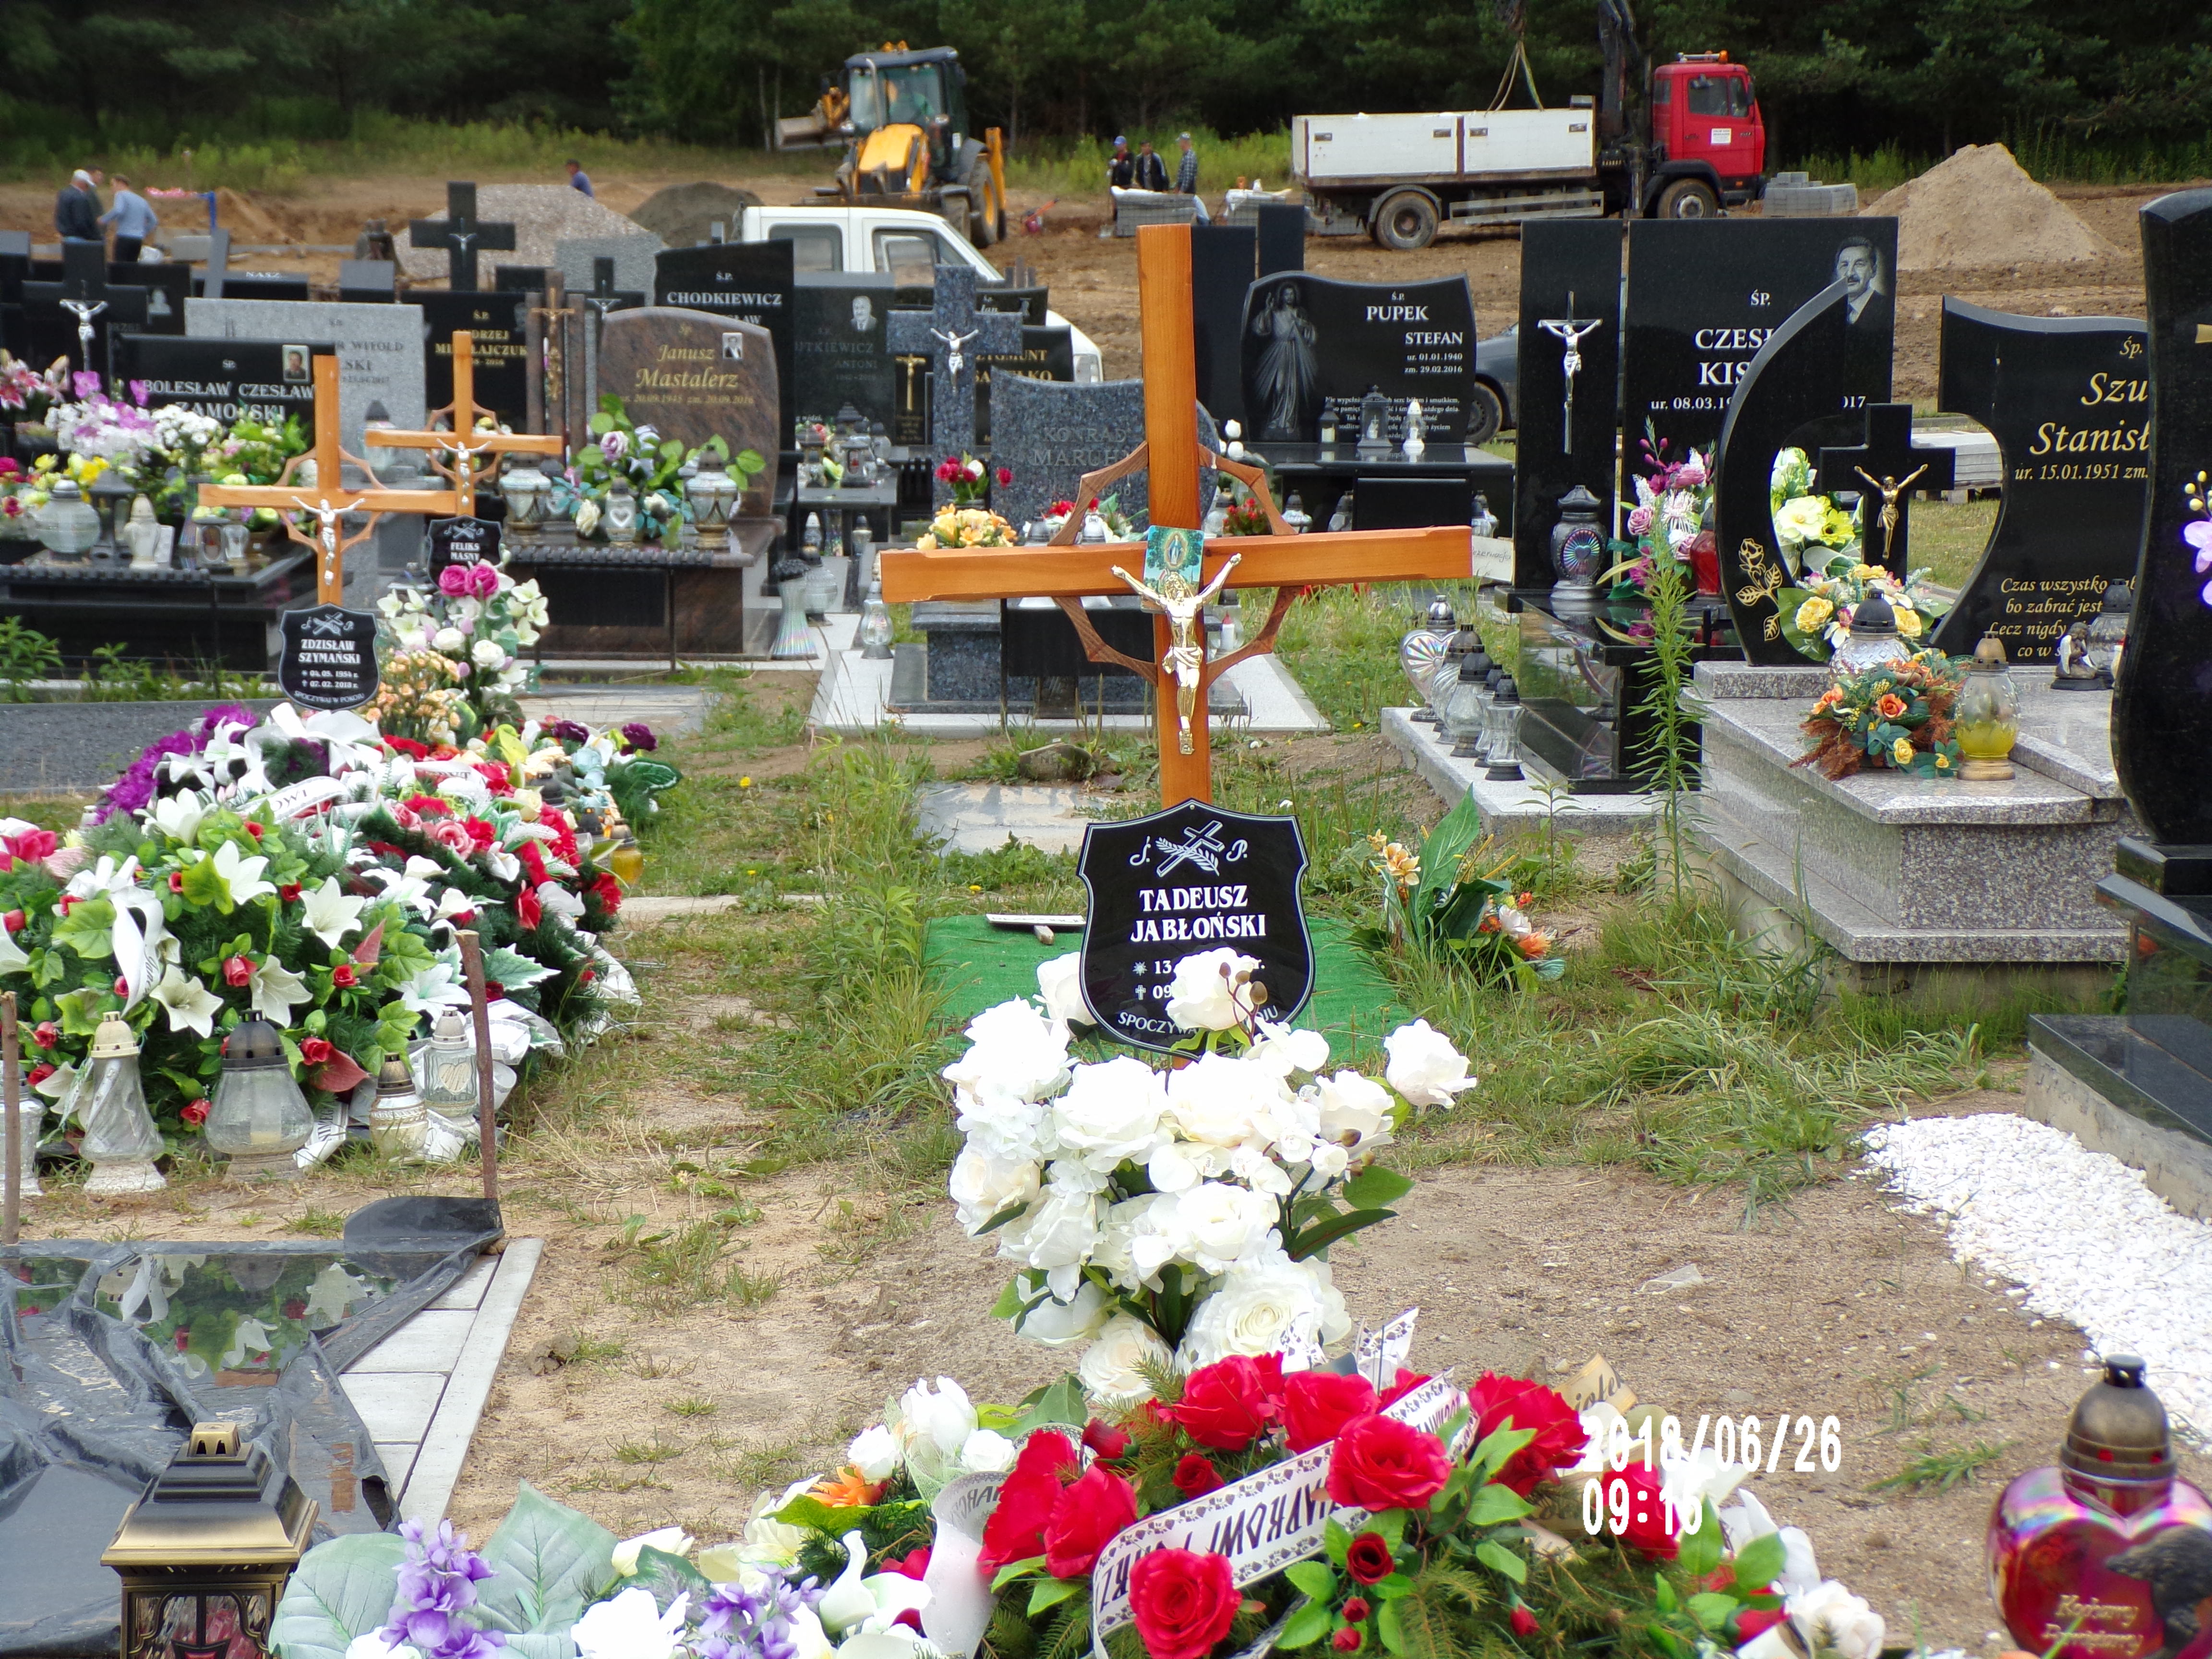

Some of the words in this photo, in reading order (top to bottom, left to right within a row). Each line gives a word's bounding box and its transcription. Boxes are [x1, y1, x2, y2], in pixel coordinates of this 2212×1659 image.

[667, 291, 783, 305] CHODKIEWICZ
[1366, 305, 1429, 321] PUPEK
[1405, 331, 1463, 345] STEFAN
[1695, 328, 1775, 349] CZESŁ
[2119, 335, 2143, 359] Śp.
[657, 344, 715, 361] Janusz
[635, 366, 739, 387] Mastalerz
[1698, 361, 1751, 385] KIS
[2081, 372, 2148, 406] Szu
[176, 401, 286, 421] ZAMOSKI
[1651, 400, 1668, 410] ur.
[2029, 419, 2150, 456] Stanisł
[2015, 468, 2033, 480] ur.
[2039, 463, 2120, 480] 15.01.1951
[2123, 467, 2149, 479] zm.
[2001, 577, 2036, 593] Czas
[2040, 575, 2108, 596] wszystko
[2006, 598, 2022, 614] bo
[2025, 597, 2076, 613] zabrać
[2074, 599, 2103, 618] jest
[1989, 622, 2022, 636] Lecz
[2027, 619, 2067, 640] nigdy
[301, 638, 356, 651] ZDZISŁAW
[2017, 647, 2033, 657] co
[2037, 647, 2052, 657] w
[298, 650, 361, 663] SZYMAŃSKI
[1139, 885, 1249, 912] TADEUSZ
[1130, 911, 1267, 942] JABŁOŃSKI
[1154, 960, 1172, 974] 13
[1152, 985, 1172, 999] 09
[1117, 1010, 1199, 1034] SPOCZYWA
